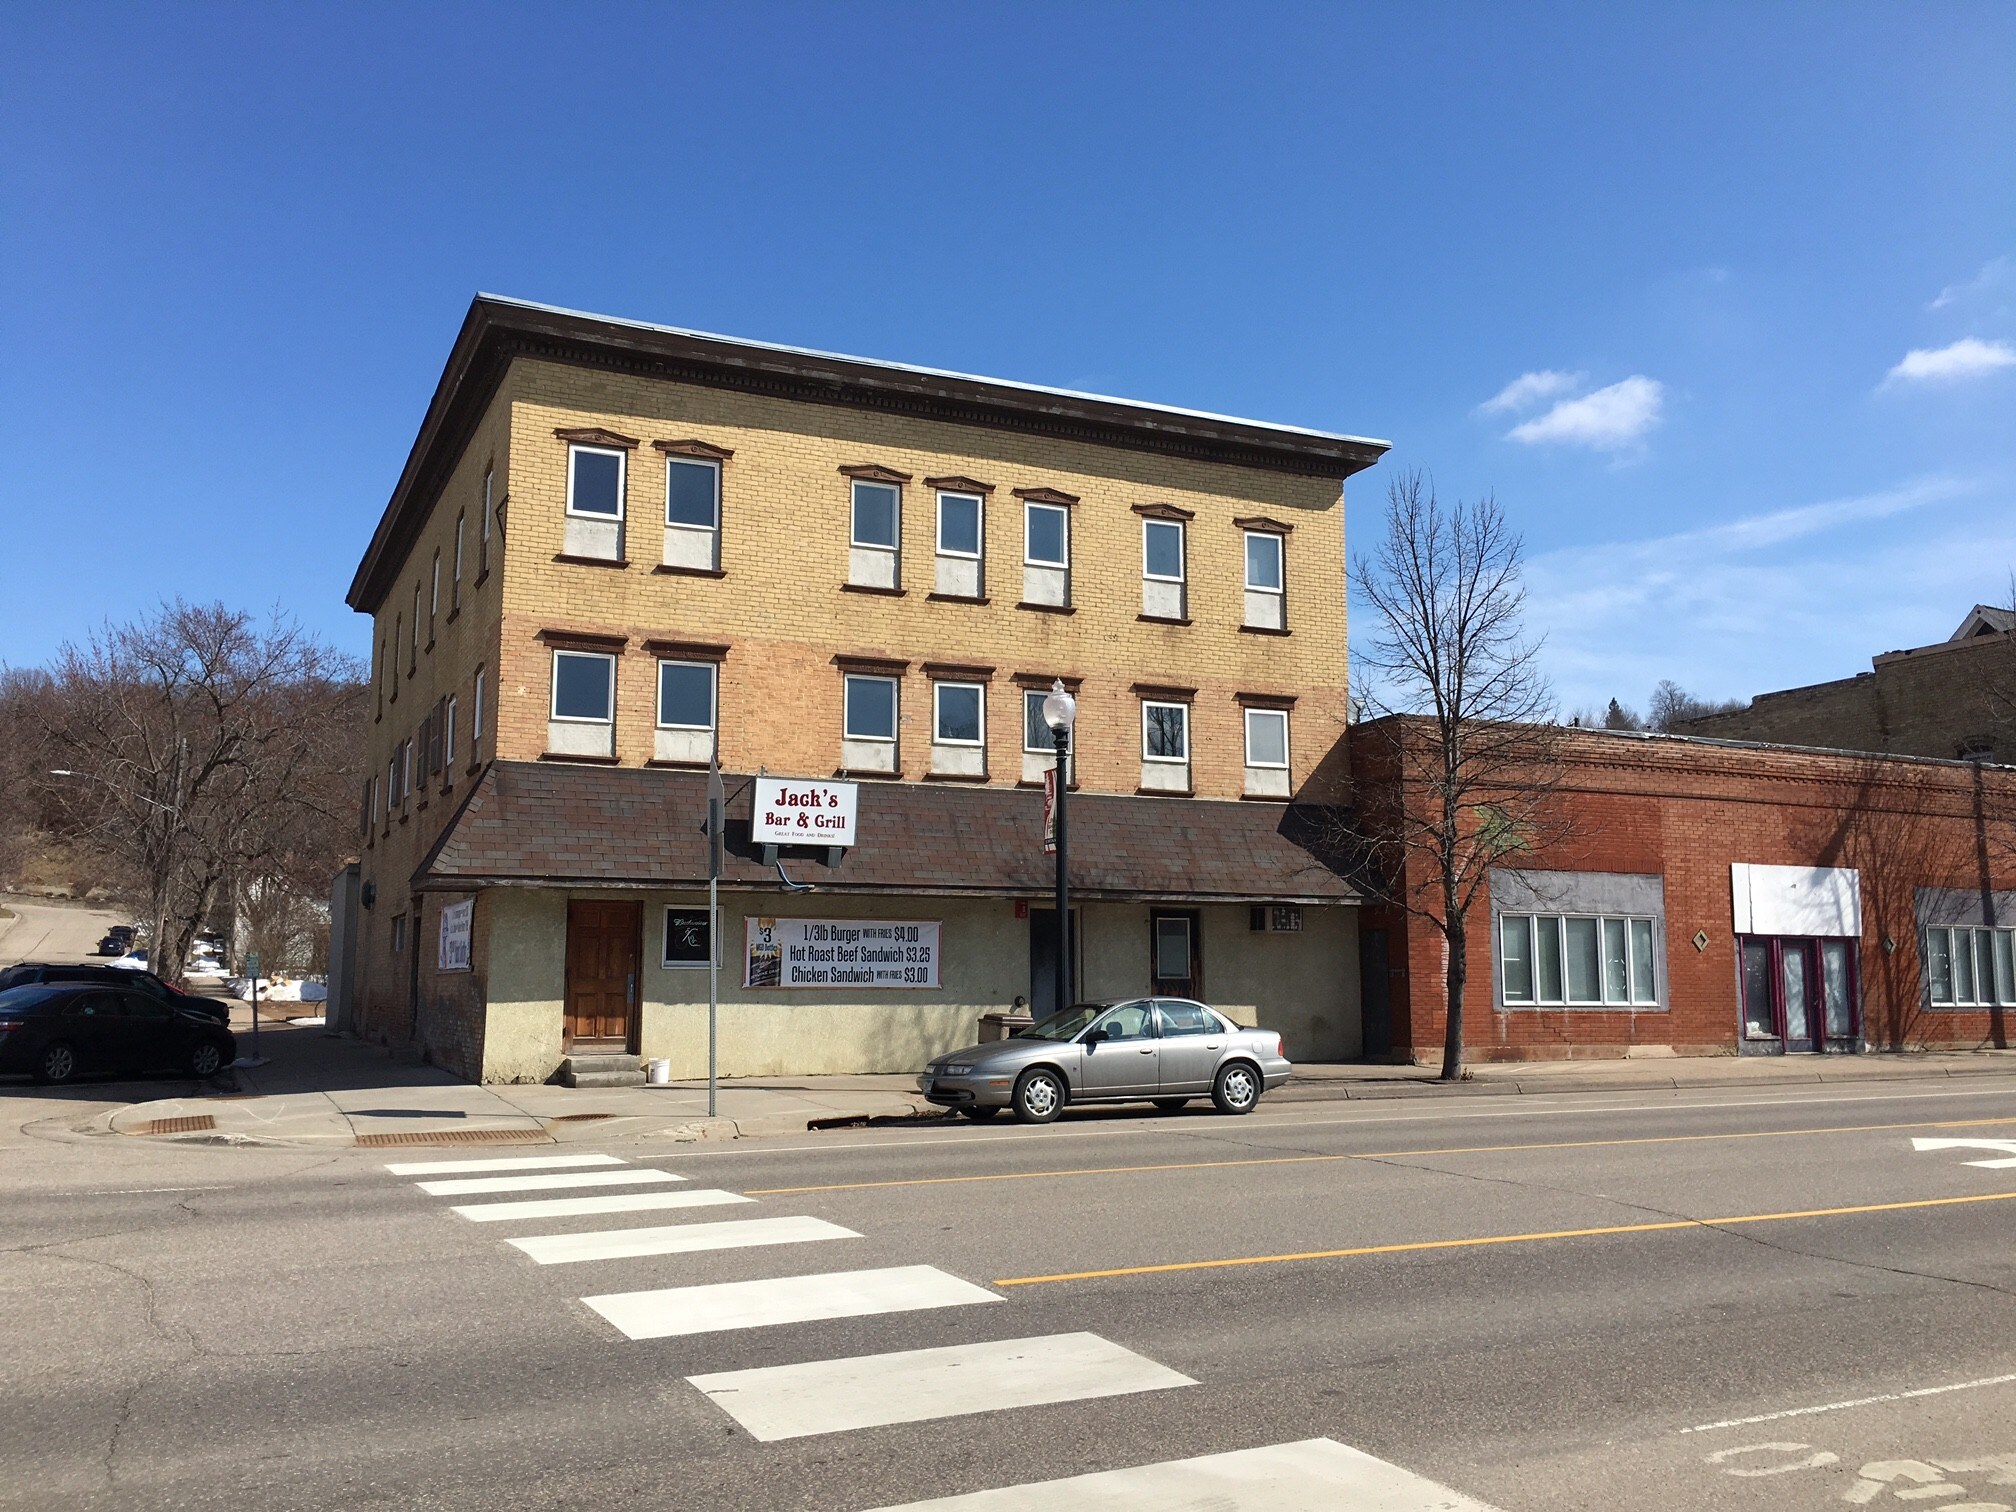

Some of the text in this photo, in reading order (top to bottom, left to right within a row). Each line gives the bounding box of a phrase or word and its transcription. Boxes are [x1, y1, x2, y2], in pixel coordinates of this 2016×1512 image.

[775, 787, 838, 808] Jack's
[765, 811, 846, 829] Bar & Grill
[759, 927, 772, 943] $3
[803, 924, 919, 945] 1/3lb Burger WITH FRIES $4.00
[789, 945, 931, 963] Hot Roast Beef Sandwich $3.25
[791, 965, 828, 983] Chicken
[830, 966, 874, 983] Sandwich
[876, 970, 889, 979] WITH
[889, 970, 903, 980] FRIES
[904, 966, 928, 983] $3.00
